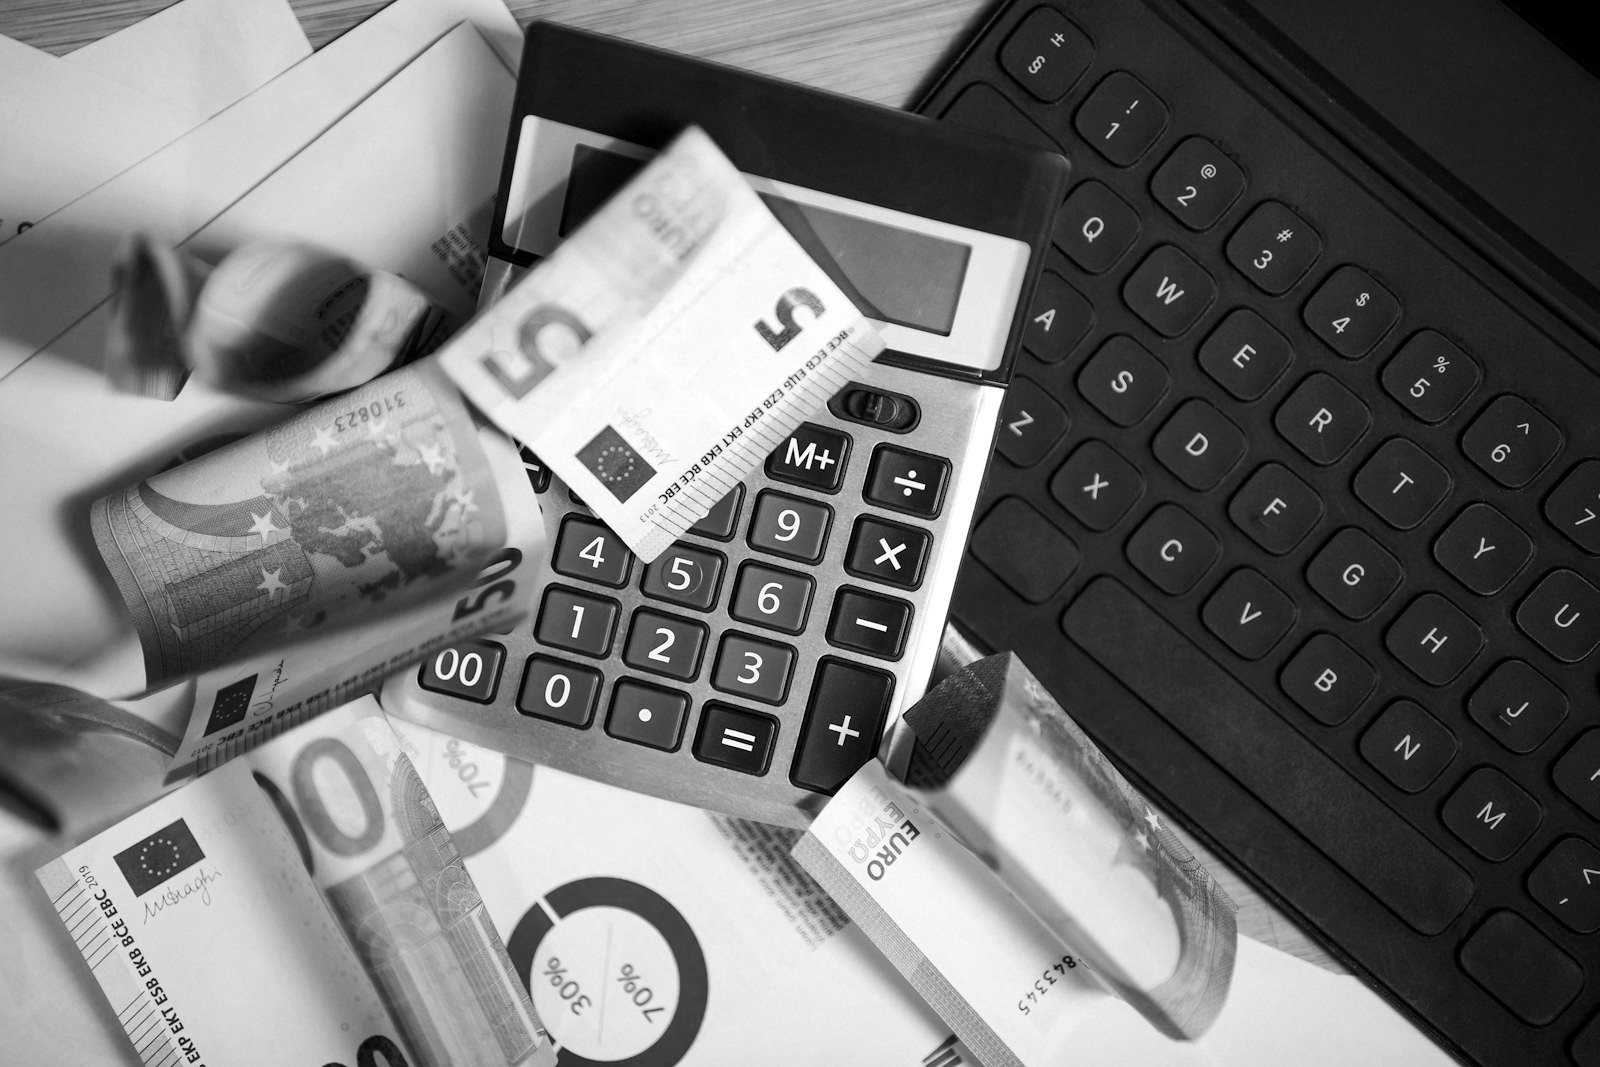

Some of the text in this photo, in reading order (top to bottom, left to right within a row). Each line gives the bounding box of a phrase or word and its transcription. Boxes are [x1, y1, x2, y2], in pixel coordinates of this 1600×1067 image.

[1125, 100, 1139, 114] !
[1105, 122, 1120, 140] 1
[1200, 163, 1217, 180] @
[1176, 185, 1197, 207] 2
[1082, 216, 1105, 243] Q
[1276, 228, 1293, 243] #
[1253, 249, 1273, 270] 3
[1156, 276, 1185, 305] W
[1355, 292, 1370, 307] $
[753, 286, 826, 353] 5
[1034, 308, 1056, 332] A
[1331, 316, 1351, 334] 4
[482, 304, 593, 400] 5
[805, 349, 829, 371] ECB
[1232, 343, 1257, 369] E
[1432, 355, 1451, 374] %
[1111, 370, 1134, 393] S
[1409, 377, 1431, 398] 5
[334, 390, 407, 433] 310823
[763, 387, 786, 410] EZB
[744, 406, 765, 429] EKP
[1009, 410, 1034, 436] Z
[1308, 407, 1333, 433] R
[722, 425, 744, 448] EKT
[1185, 432, 1209, 457] D
[700, 442, 724, 467] EKB
[783, 436, 837, 471] M+
[1491, 443, 1511, 463] 6
[658, 482, 682, 505] EBC
[1083, 472, 1110, 500] X
[1392, 471, 1415, 494] T
[638, 502, 661, 524] 2013
[1263, 497, 1287, 516] F
[1574, 508, 1596, 526] 7
[774, 509, 801, 542] 9
[578, 536, 605, 569] 4
[1160, 539, 1183, 562] C
[1473, 537, 1496, 560] Y
[666, 558, 695, 591] 5
[1342, 563, 1365, 586] G
[757, 582, 784, 615] 6
[571, 605, 585, 639] 1
[1240, 601, 1262, 625] V
[1554, 603, 1580, 628] U
[647, 627, 676, 664] 2
[1420, 627, 1448, 654] H
[434, 648, 483, 687] 00
[736, 651, 763, 684] 3
[1314, 668, 1338, 692] B
[544, 673, 571, 708] 0
[1506, 701, 1530, 718] J
[1393, 734, 1421, 761] N
[442, 739, 490, 799] 70%
[1476, 801, 1507, 830] M
[867, 820, 921, 881] EURO
[78, 864, 99, 890] 2019
[94, 888, 118, 919] EBC
[128, 948, 152, 977] EKB
[146, 977, 168, 1006] ESB
[543, 956, 593, 1016] 30%
[616, 963, 665, 1024] 70%
[1018, 955, 1079, 1016] 843345
[161, 1007, 184, 1035] EKT
[178, 1036, 201, 1064] EKP
